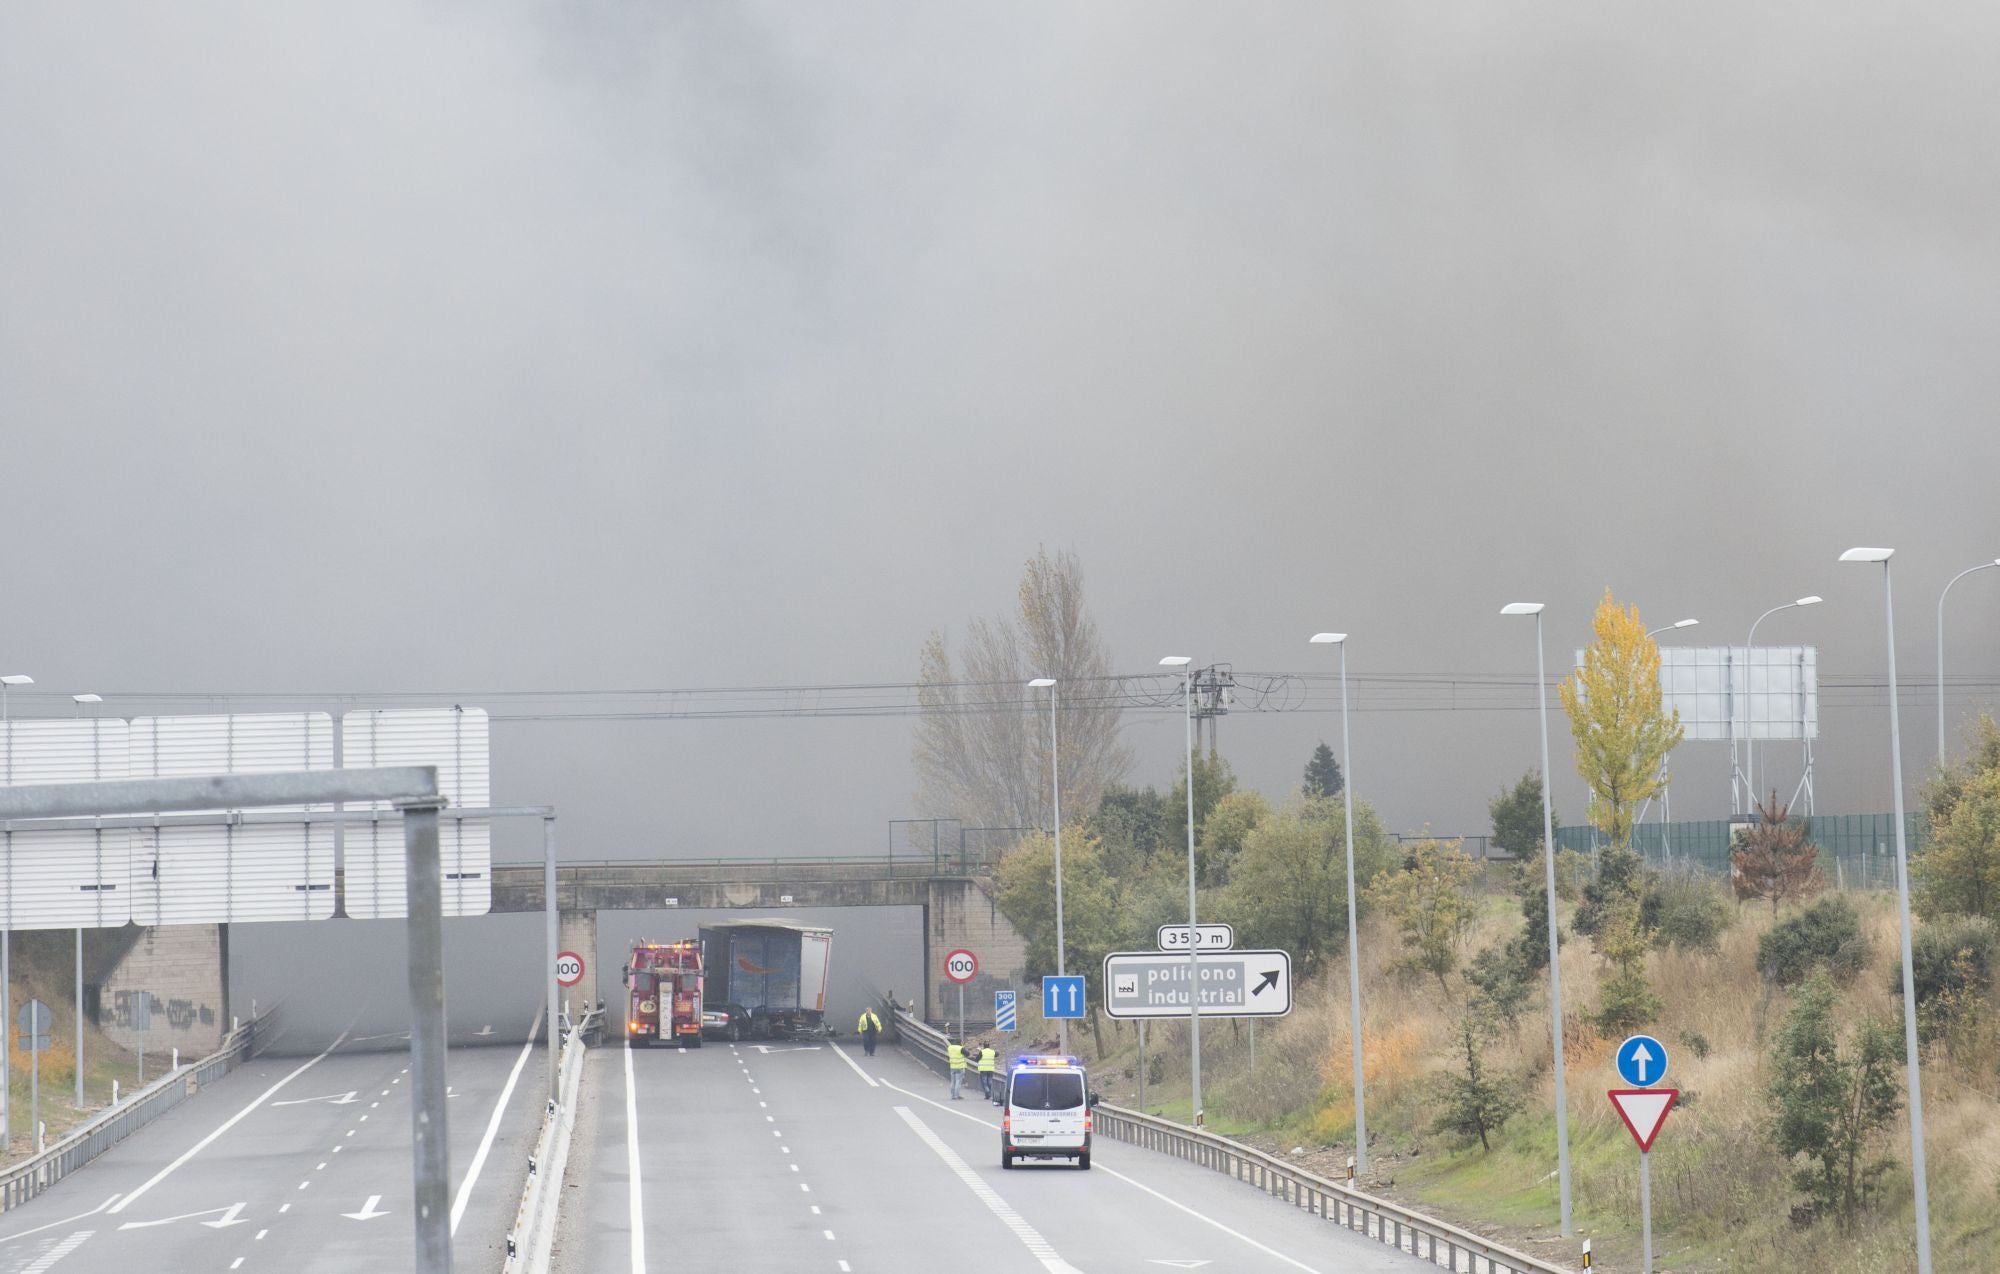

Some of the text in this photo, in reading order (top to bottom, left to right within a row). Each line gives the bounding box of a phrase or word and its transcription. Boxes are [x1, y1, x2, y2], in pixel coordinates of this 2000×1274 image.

[1211, 935, 1223, 943] m
[950, 960, 974, 972] 100
[1148, 988, 1242, 1004] indutrial
